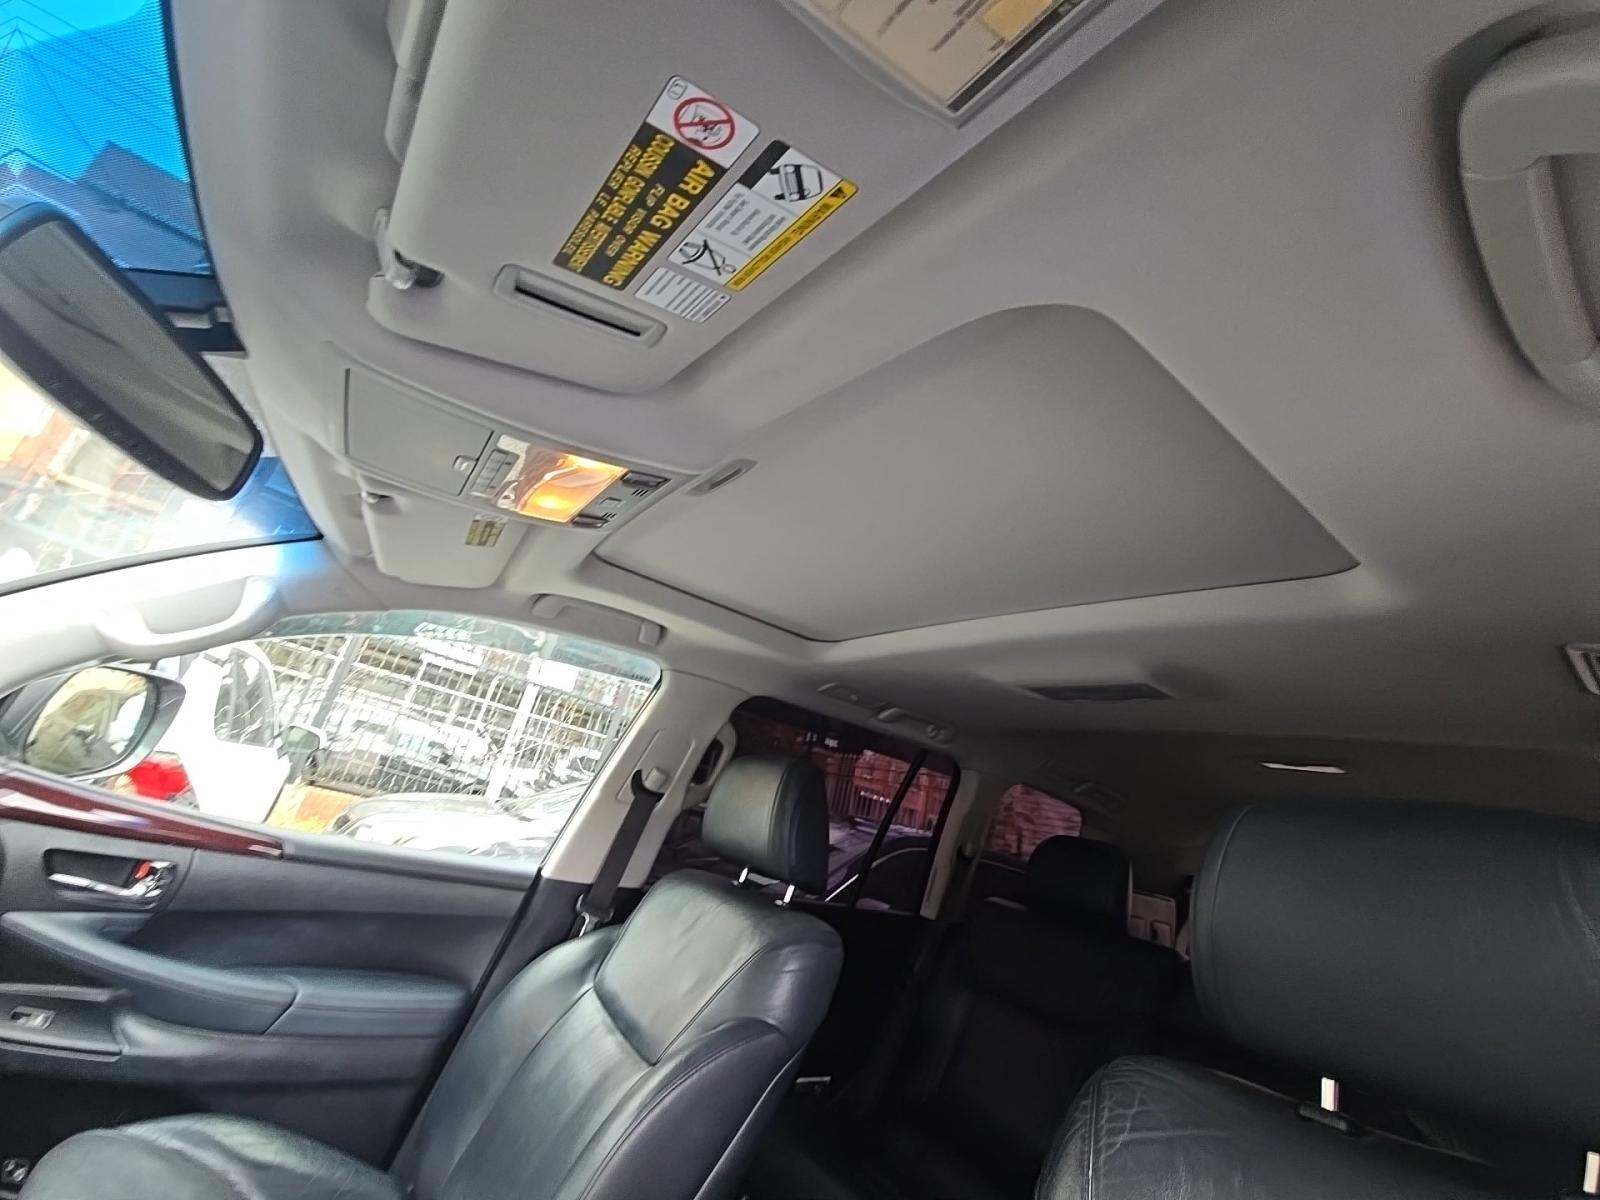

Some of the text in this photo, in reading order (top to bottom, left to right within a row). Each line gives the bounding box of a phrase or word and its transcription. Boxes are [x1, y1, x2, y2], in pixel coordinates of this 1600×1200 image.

[677, 158, 718, 196] AIR
[595, 191, 611, 206] LE
[648, 191, 691, 231] BAG
[601, 227, 662, 287] WARNING
